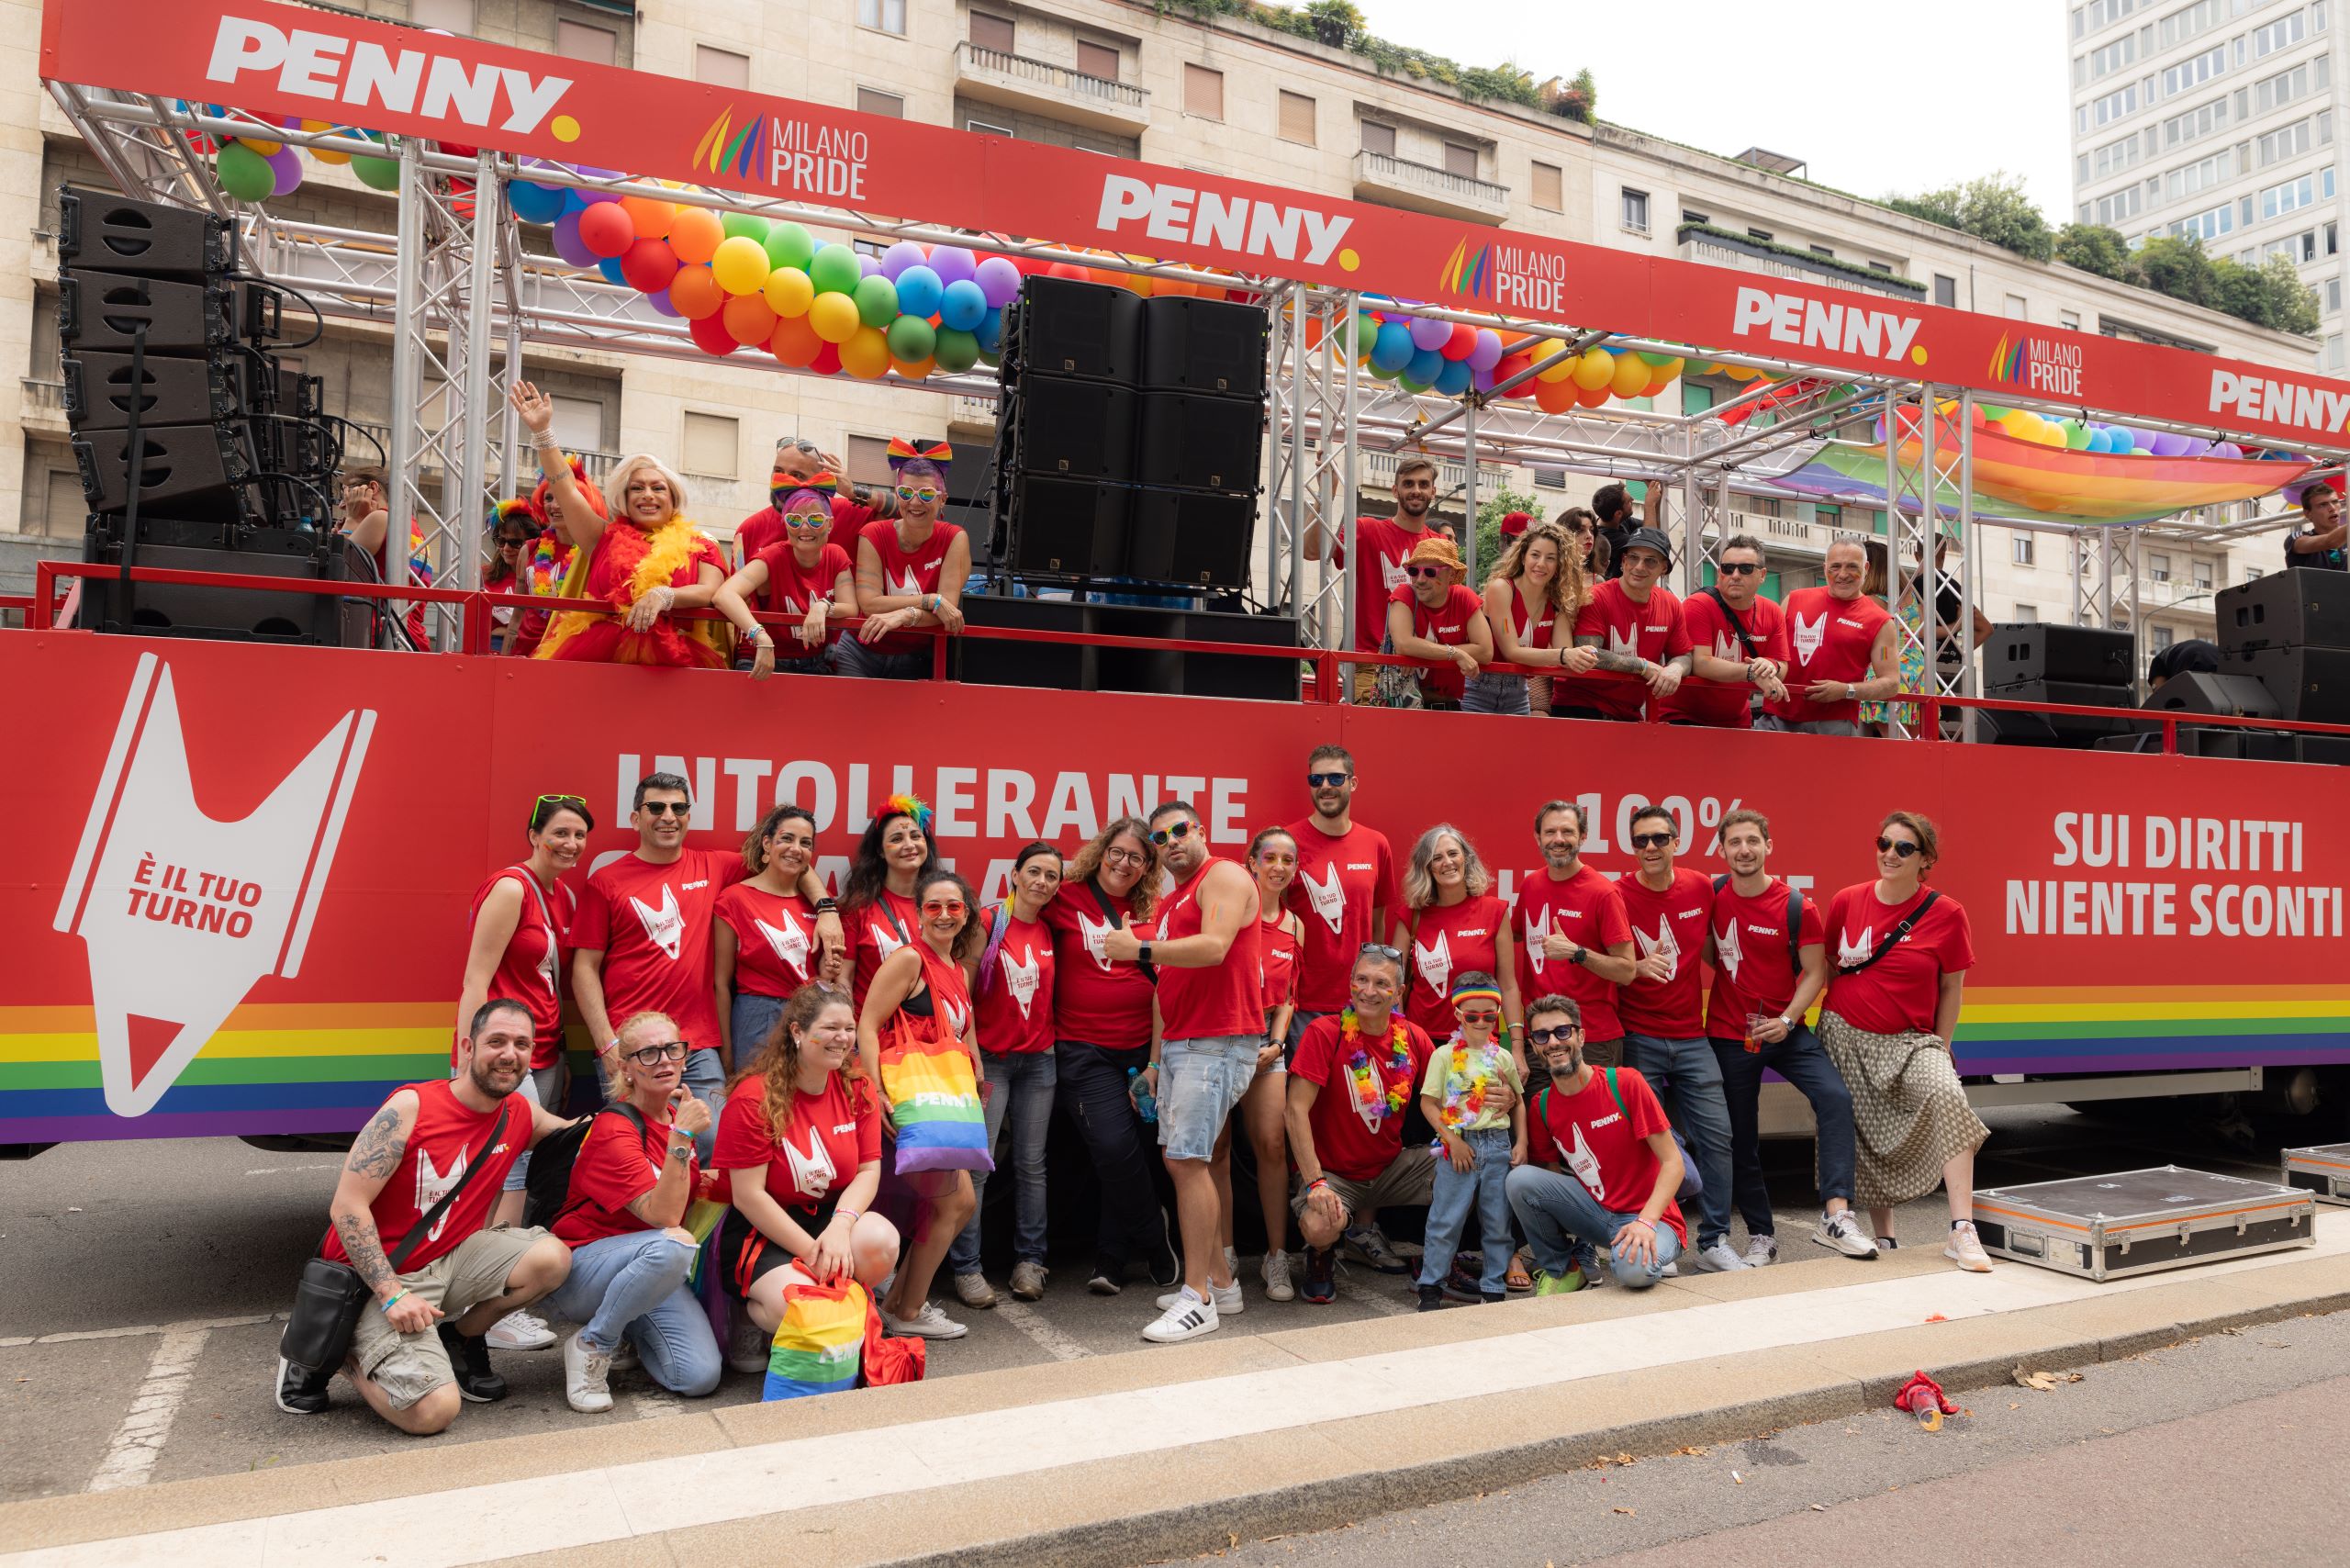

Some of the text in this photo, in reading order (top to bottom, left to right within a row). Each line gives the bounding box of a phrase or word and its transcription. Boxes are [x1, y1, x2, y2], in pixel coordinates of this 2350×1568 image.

[772, 117, 868, 162] MILANO
[771, 150, 867, 201] PRIDE
[1496, 244, 1565, 282] MILANO
[1496, 272, 1565, 314] PRIDE
[2030, 338, 2082, 367] MILANO
[2030, 362, 2083, 398] PRIDE
[2053, 812, 2302, 872] SUI DIRITTI
[134, 851, 262, 907] È IL TUO
[128, 888, 252, 938] TURNO
[2006, 879, 2343, 937] NIENTE SCONTI
